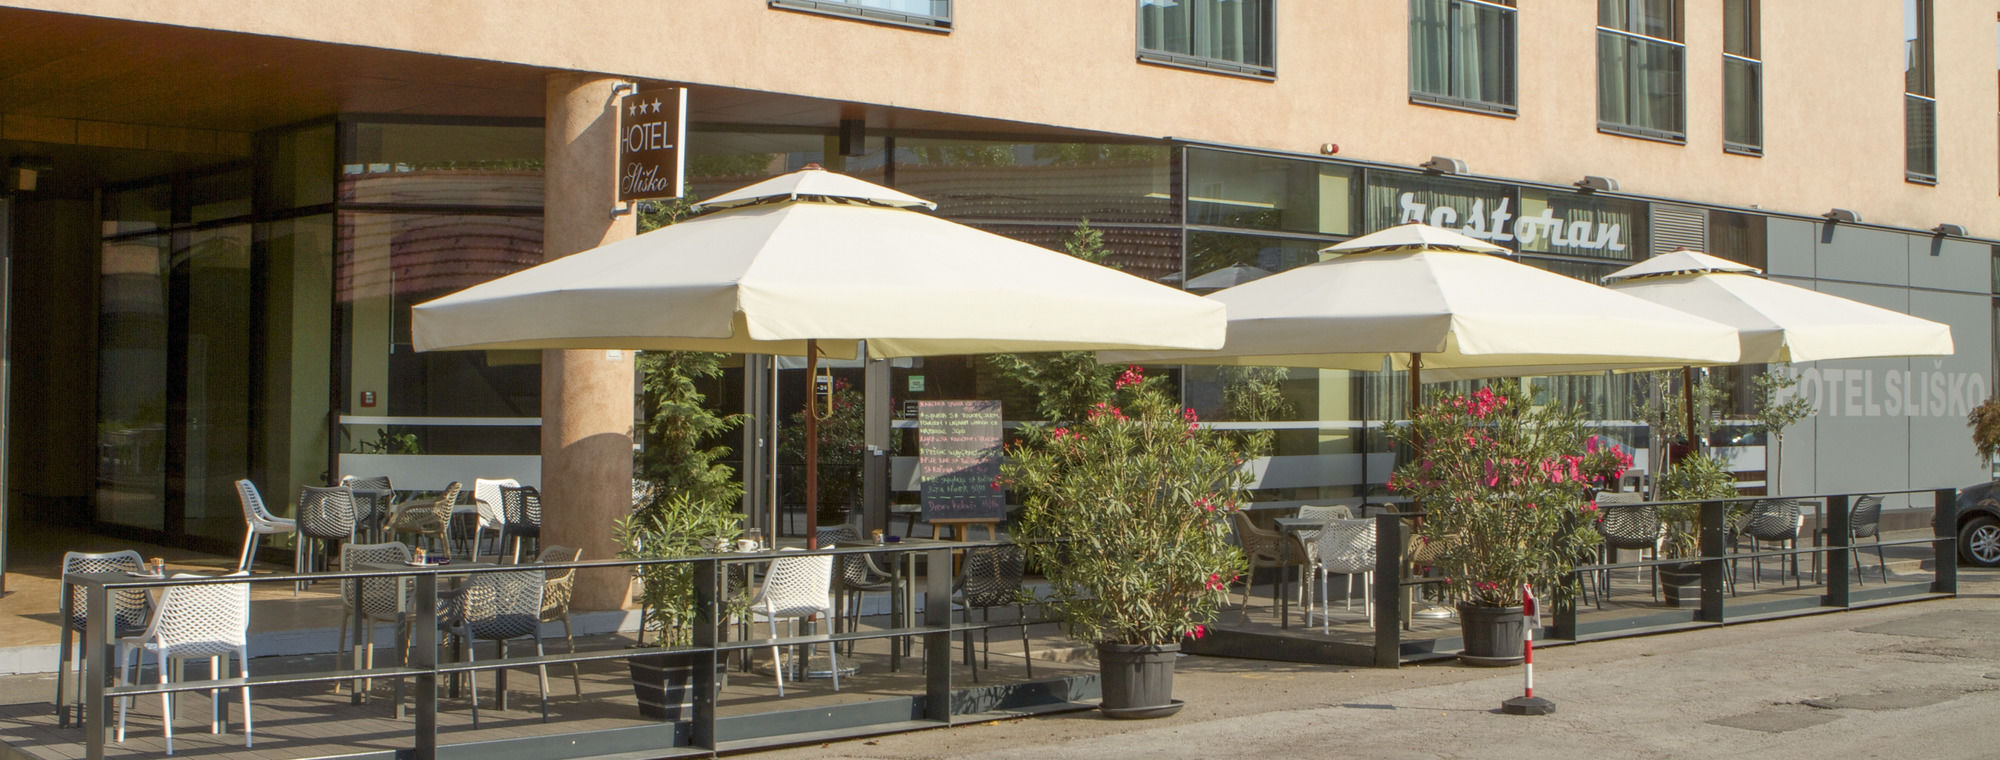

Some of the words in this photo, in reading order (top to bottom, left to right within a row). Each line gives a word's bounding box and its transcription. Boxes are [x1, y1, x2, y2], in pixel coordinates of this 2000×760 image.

[621, 121, 673, 153] HOTEL
[622, 162, 668, 194] Sliško
[1885, 360, 1985, 417] SLIŠKO
